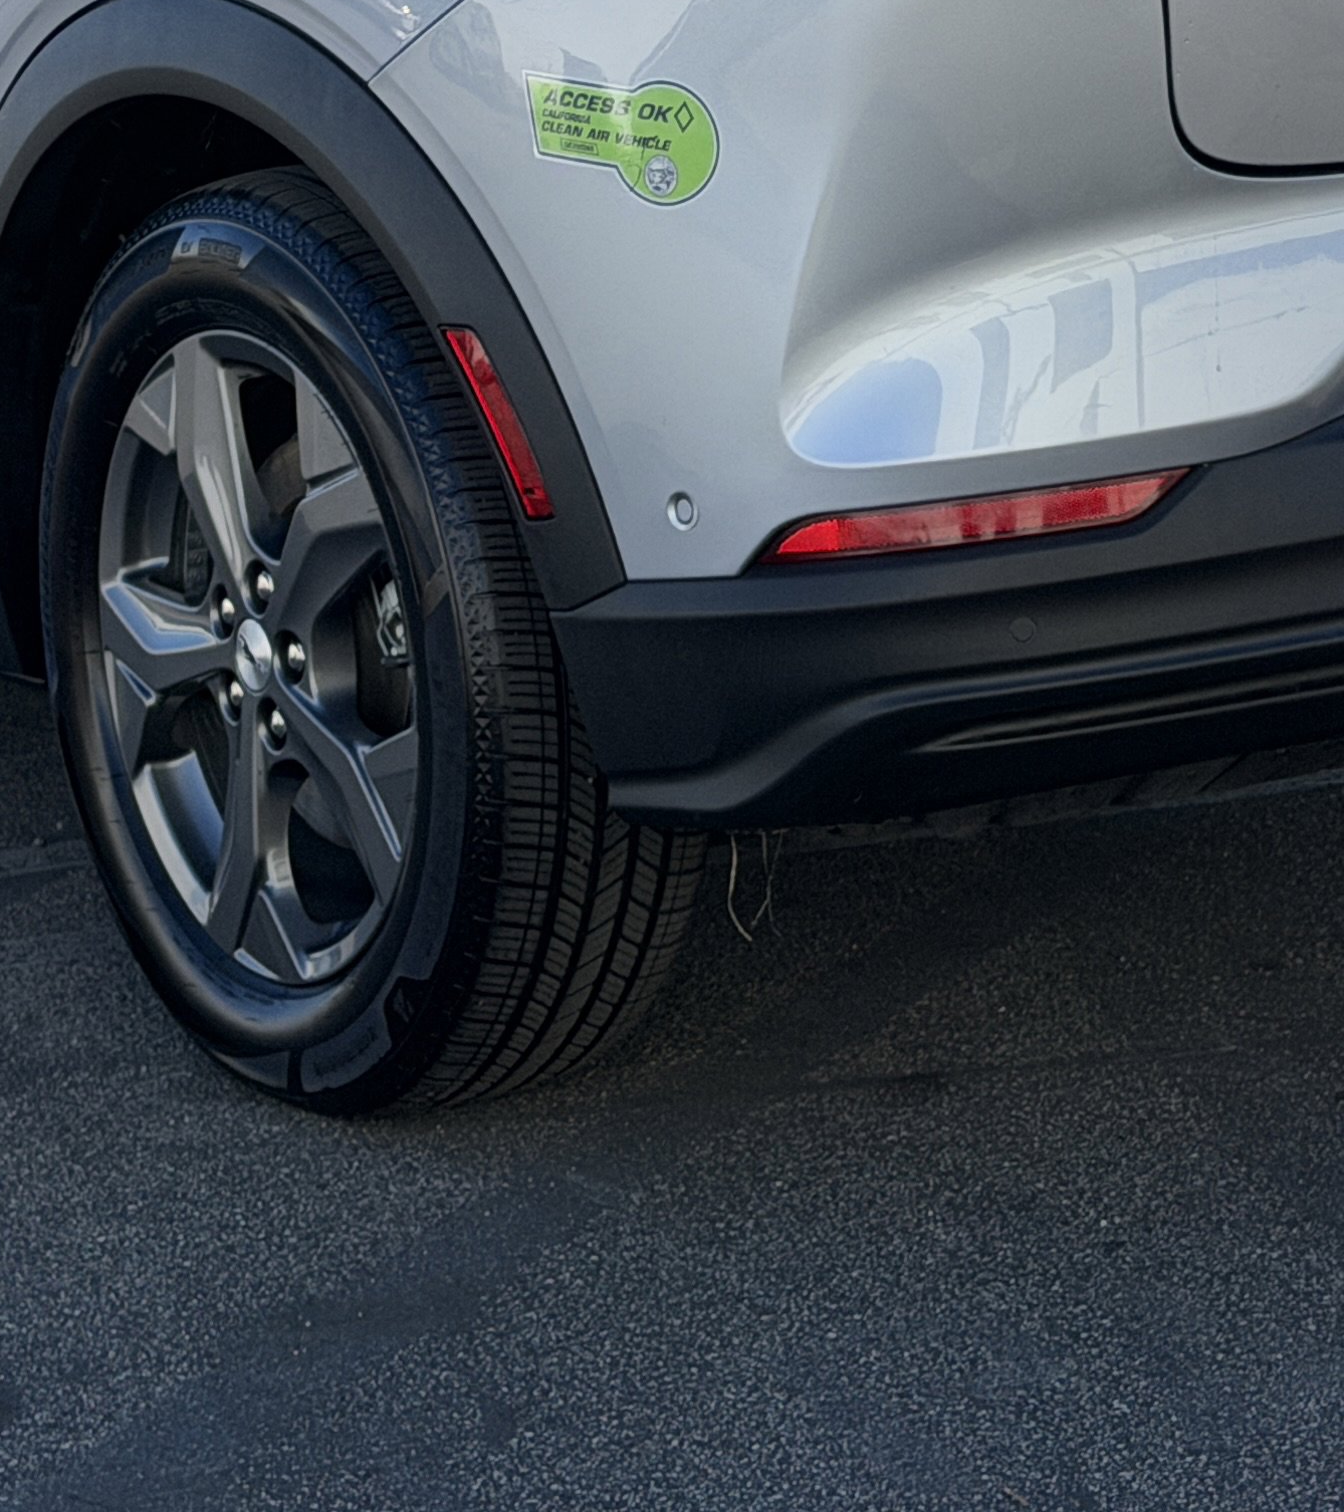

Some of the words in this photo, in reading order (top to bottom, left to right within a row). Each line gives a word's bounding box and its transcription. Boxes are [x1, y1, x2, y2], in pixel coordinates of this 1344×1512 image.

[543, 89, 631, 116] ACCESS
[637, 103, 673, 123] OK
[541, 120, 584, 138] CLEAN
[587, 127, 610, 143] AIR
[615, 132, 672, 152] VEHICLE
